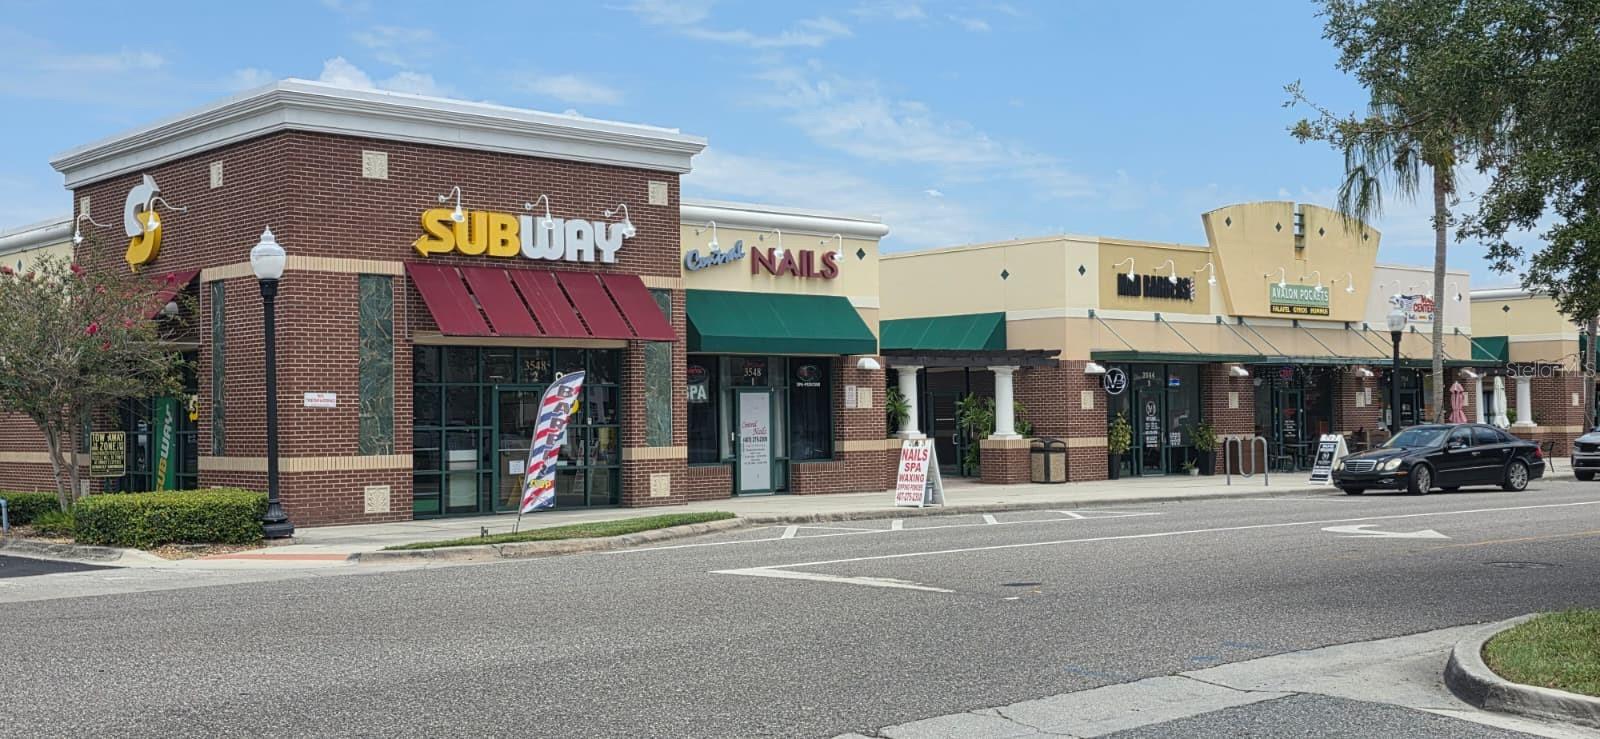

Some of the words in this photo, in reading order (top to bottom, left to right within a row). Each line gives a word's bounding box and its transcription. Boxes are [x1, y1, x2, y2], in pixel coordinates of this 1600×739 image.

[411, 209, 629, 264] SUBWAY
[684, 239, 745, 271] Central
[750, 246, 839, 279] NAILS
[1272, 287, 1298, 299] AVALON
[1300, 288, 1329, 302] POCKETS
[744, 367, 762, 377] 3548
[100, 442, 117, 451] ZONE
[902, 448, 929, 462] NAILS
[904, 462, 922, 473] SPA
[899, 473, 925, 483] WAXING
